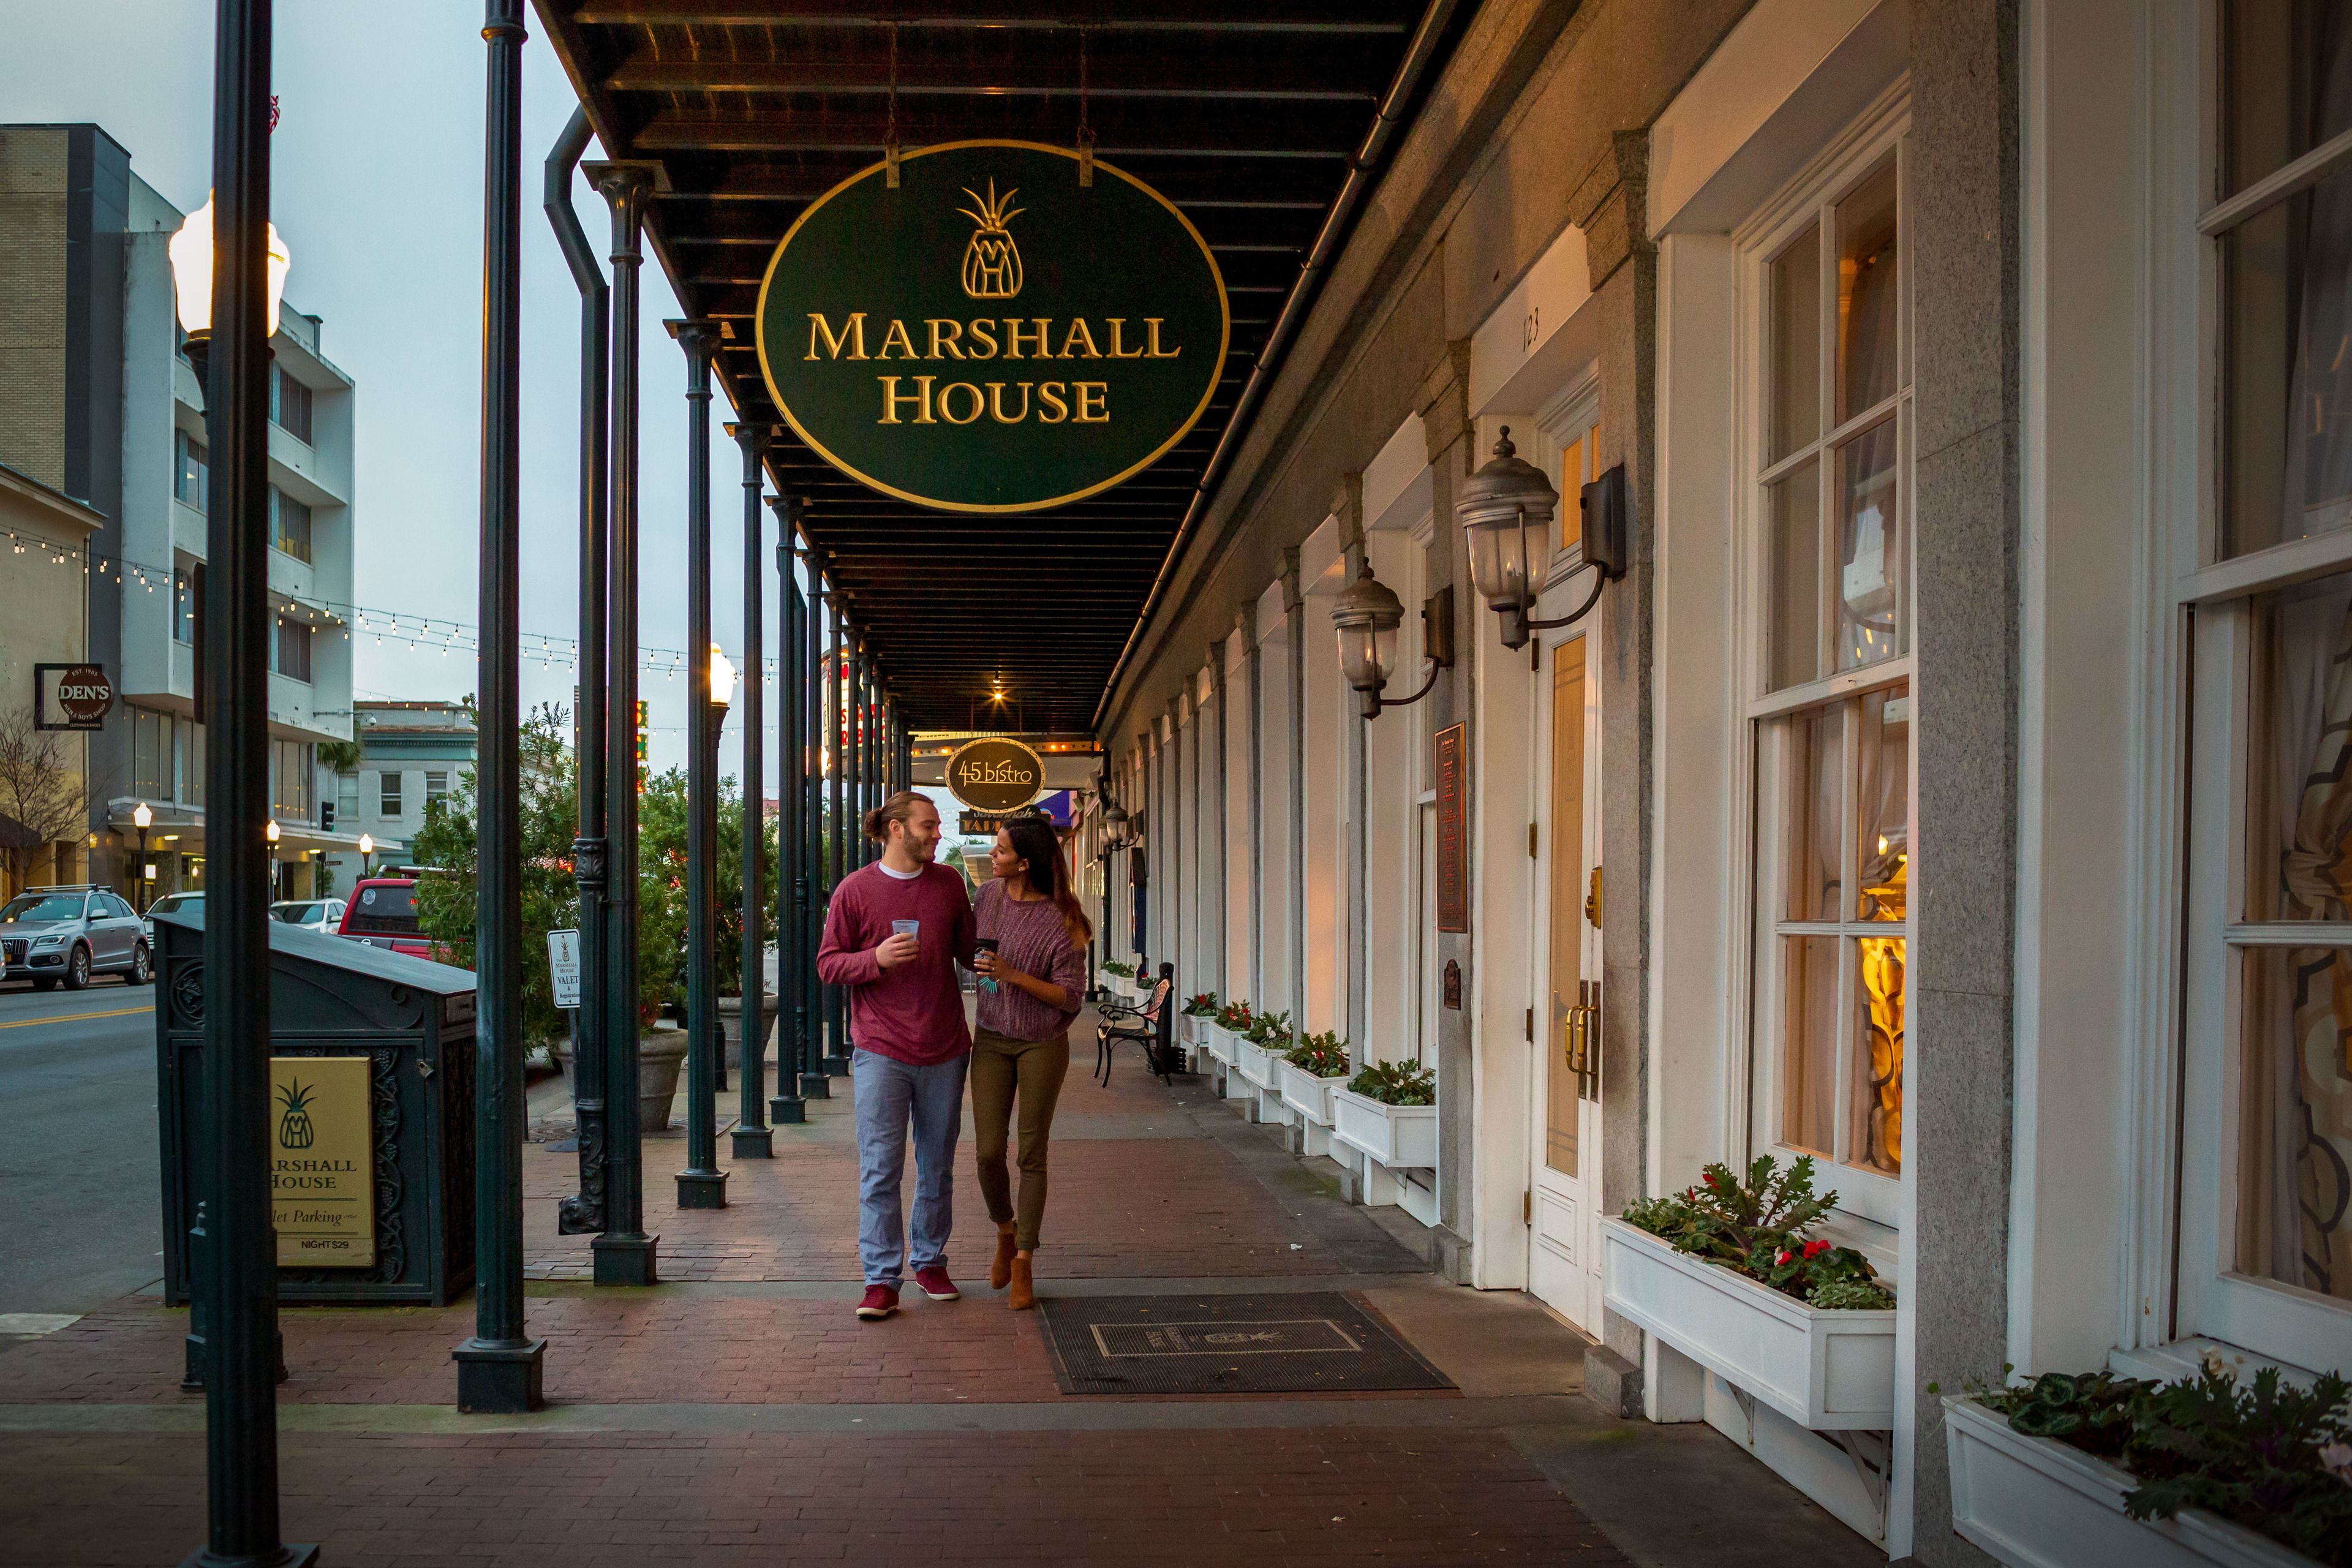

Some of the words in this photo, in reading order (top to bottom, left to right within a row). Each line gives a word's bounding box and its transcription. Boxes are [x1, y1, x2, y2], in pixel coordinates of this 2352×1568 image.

[804, 312, 1182, 361] MARSHALL
[1523, 306, 1539, 353] 123
[877, 375, 1110, 425] HOUSE
[59, 685, 109, 699] DEN'S
[64, 704, 73, 715] MEN
[93, 703, 105, 717] SHOP
[958, 760, 981, 787] 45
[985, 760, 1032, 783] bistro
[557, 976, 578, 984] VALET
[272, 1210, 288, 1223] let
[293, 1210, 342, 1226] Parking
[301, 1240, 331, 1249] NIGHT
